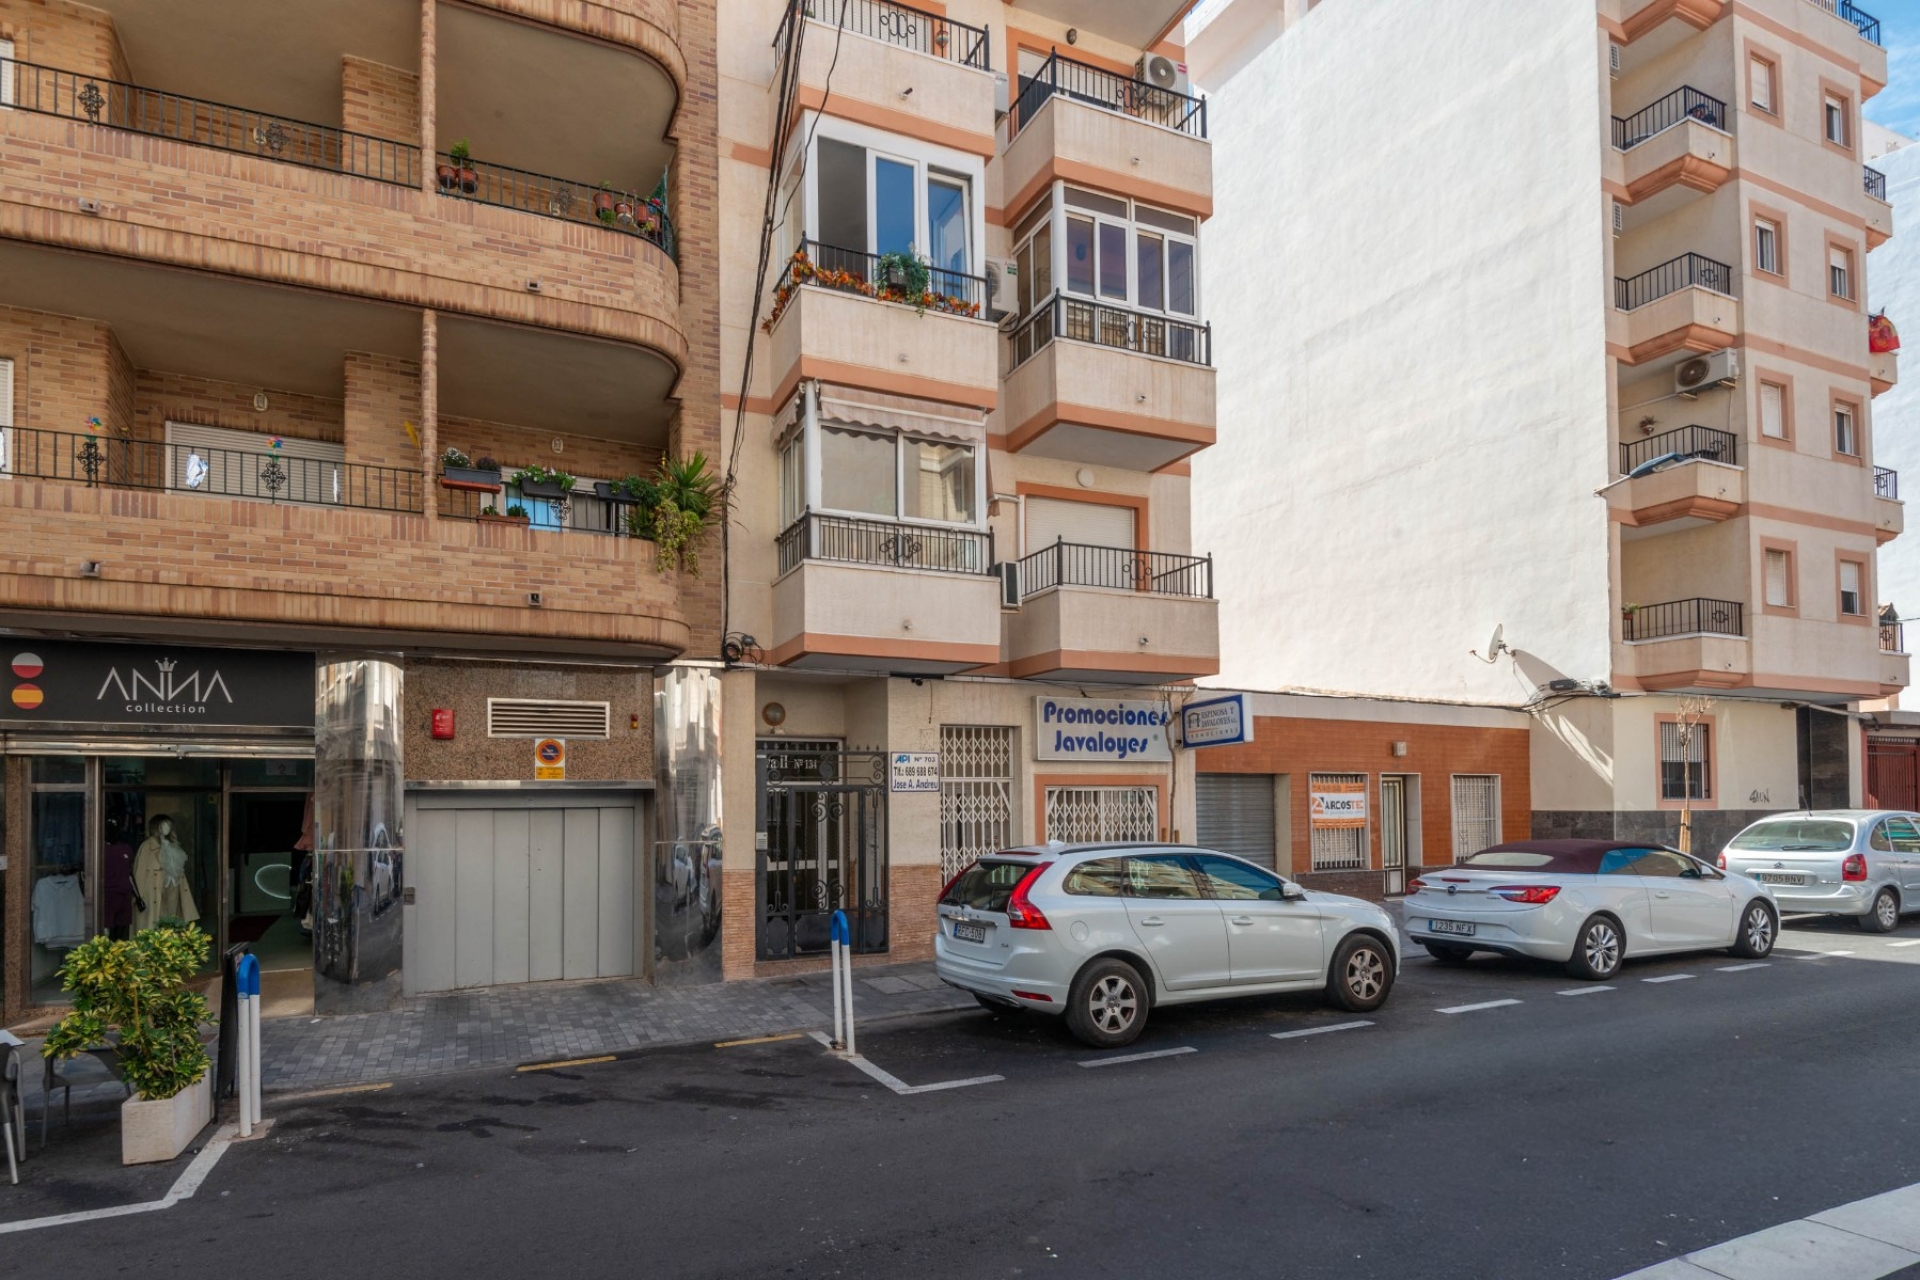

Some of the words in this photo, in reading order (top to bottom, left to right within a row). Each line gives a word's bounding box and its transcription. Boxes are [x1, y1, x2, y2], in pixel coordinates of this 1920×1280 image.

[126, 703, 206, 713] collection
[1043, 701, 1168, 726] Promociones
[1200, 708, 1228, 719] ESPINOSA
[1229, 706, 1235, 715] Y
[1201, 715, 1231, 727] JAVALOYES
[1054, 730, 1148, 759] Javaloyes
[895, 754, 911, 764] API
[927, 766, 938, 777] 674
[893, 778, 907, 789] Jose
[908, 778, 915, 789] A.
[916, 778, 938, 789] Andreu
[1324, 800, 1364, 810] ARCOSTEC
[1434, 921, 1454, 931] 1235
[1455, 923, 1473, 933] NFX
